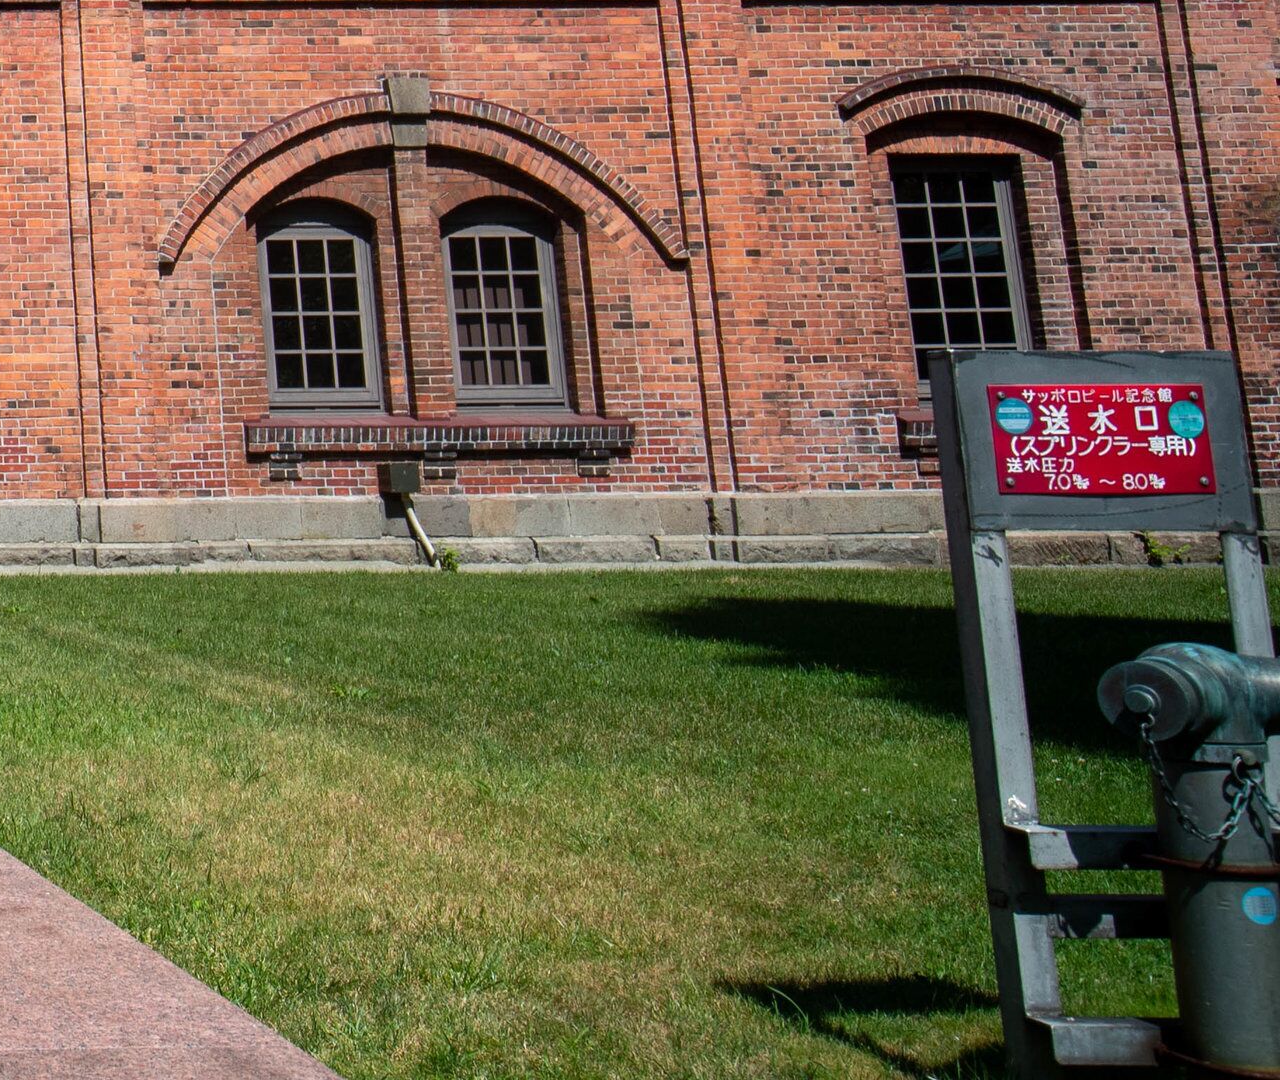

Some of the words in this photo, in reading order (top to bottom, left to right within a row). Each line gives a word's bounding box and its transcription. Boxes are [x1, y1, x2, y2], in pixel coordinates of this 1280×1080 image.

[1039, 404, 1159, 436] 送水口
[1006, 457, 1075, 474] 送水圧力
